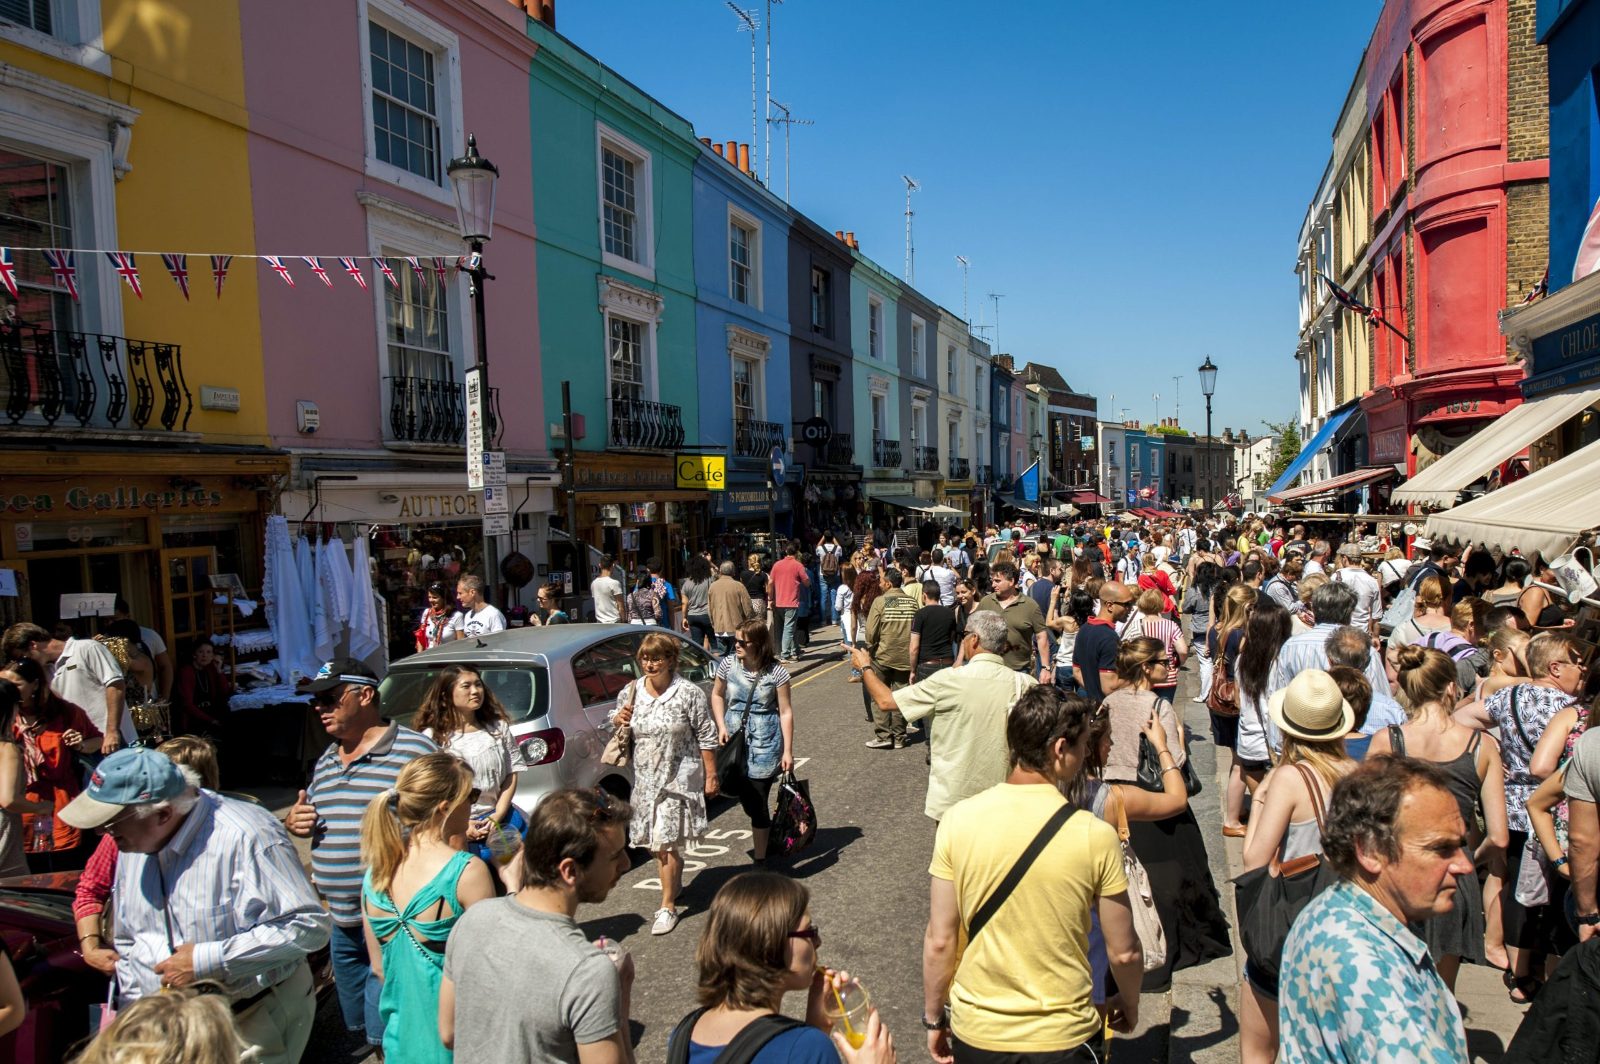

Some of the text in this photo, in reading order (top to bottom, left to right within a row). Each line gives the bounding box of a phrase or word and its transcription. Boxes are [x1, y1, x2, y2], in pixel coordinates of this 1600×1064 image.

[805, 426, 827, 439] Oi!
[679, 460, 723, 482] Café
[65, 486, 224, 511] Galleries
[399, 494, 479, 517] AUTHOR
